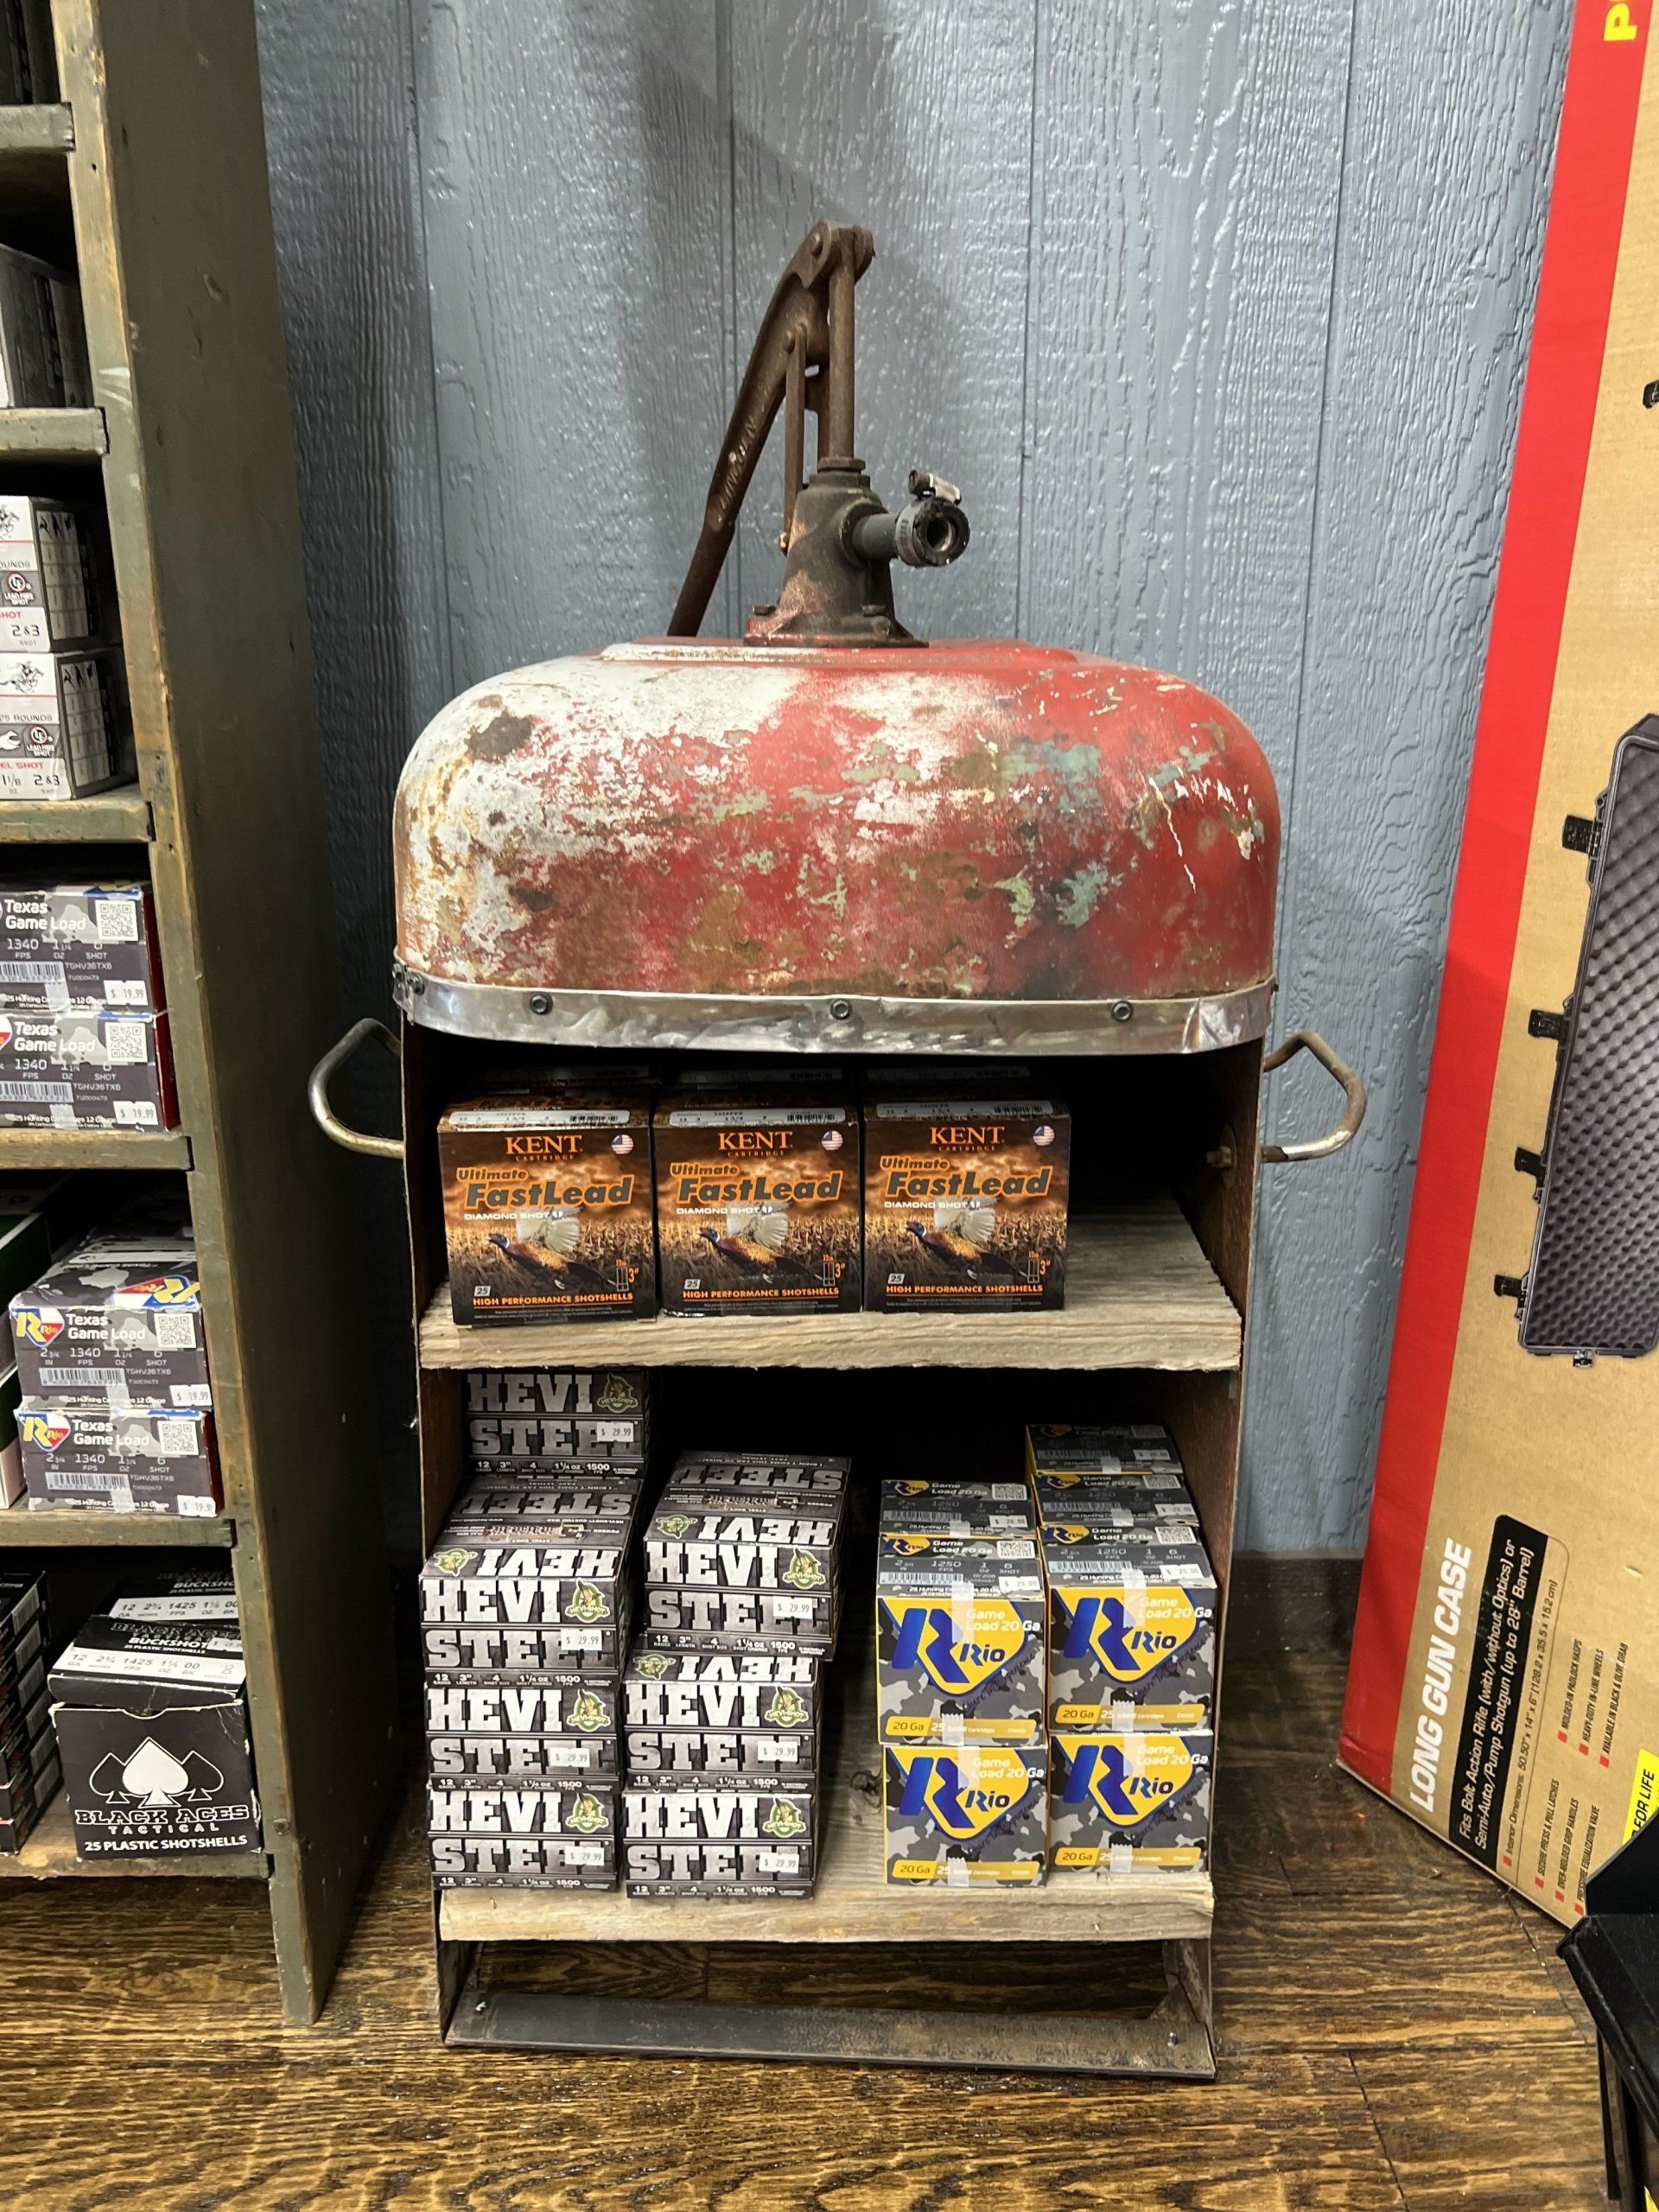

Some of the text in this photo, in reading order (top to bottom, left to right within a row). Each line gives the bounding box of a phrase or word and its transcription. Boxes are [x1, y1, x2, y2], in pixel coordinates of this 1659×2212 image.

[4, 899, 48, 913] Texas
[5, 916, 86, 930] Game Load
[7, 938, 39, 950] 1340
[124, 988, 145, 999] 19.99
[14, 1022, 58, 1036] Texas
[14, 1038, 96, 1052] Game Load
[14, 1058, 48, 1071] 1340
[133, 1109, 154, 1119] 19.99
[717, 1131, 793, 1151] KENT
[930, 1126, 1005, 1145] KENT
[505, 1135, 583, 1154] KENT
[881, 1157, 949, 1169] Ultimate
[457, 1168, 528, 1181] Ultimate
[671, 1164, 740, 1176] Ultimate
[678, 1173, 841, 1202] FastLead
[887, 1168, 1051, 1195] FastLead
[466, 1176, 633, 1208] FastLead
[686, 1280, 699, 1288] 25
[890, 1274, 903, 1283] 25
[476, 1287, 490, 1295] 25
[683, 1287, 839, 1299] HIGH PERFORMANCE SHOTSHELLS
[473, 1293, 633, 1306] HIGH PERFORMANCE SHOTSHELLS
[66, 1313, 109, 1326] Texas
[68, 1327, 146, 1339] Game Load
[69, 1347, 101, 1358] 1340
[188, 1391, 209, 1401] 19.99
[467, 1374, 593, 1413] HEVI
[72, 1419, 113, 1432] Texas
[612, 1427, 631, 1436] 29.99
[73, 1433, 149, 1446] Game Load
[75, 1453, 105, 1464] 1340
[679, 1465, 843, 1491] STEEL
[697, 1516, 833, 1545] HEVI
[476, 1549, 619, 1577] HEVI
[646, 1541, 777, 1587] HEVI
[168, 1601, 197, 1610] 1425
[423, 1580, 561, 1623] HEVI
[790, 1604, 810, 1612] 29.99
[967, 1609, 1005, 1620] Game
[1194, 1607, 1212, 1618] Ga
[965, 1621, 1040, 1631] Load 20 Ga
[129, 1637, 210, 1649] BUCKSHOT
[578, 1636, 599, 1645] 29.99
[771, 1641, 795, 1650] 1500
[1131, 1631, 1177, 1653] Rio
[959, 1643, 1005, 1666] Rio
[123, 1657, 154, 1666] 1425
[677, 1656, 812, 1681] HEVI
[1409, 1537, 1471, 1812] LONG GUN CASE
[1614, 1662, 1625, 1682] OLIVE
[1459, 1539, 1516, 1840] Fits Bolt Action Rifle (with/without Optics) or
[1582, 1700, 1597, 1743] HEAVY-DUTY
[1593, 1648, 1605, 1678] WHEELS
[1475, 1546, 1535, 1850] Semi-Auto/Pump Shotgun (up to 28" Barrel)
[1611, 1686, 1621, 1712] BLACK
[428, 1688, 562, 1732] HEVI
[626, 1684, 760, 1726] HEVI
[1063, 1709, 1077, 1718] 20
[909, 1722, 925, 1731] Ga
[1602, 1717, 1614, 1755] AVAILABLE
[568, 1753, 588, 1762] 29.99
[973, 1758, 1010, 1768] Game
[1191, 1754, 1209, 1764] Ga
[1027, 1768, 1045, 1778] Ga
[1128, 1777, 1173, 1798] Rio
[1639, 1768, 1655, 1801] LIFE
[965, 1790, 1010, 1811] Rio
[75, 1805, 250, 1825] BLACK ACES
[430, 1791, 562, 1832] HEVI
[625, 1796, 759, 1838] HEVI
[1590, 1803, 1600, 1827] VALVE
[1634, 1802, 1649, 1831] FOR
[109, 1822, 219, 1834] TACTICAL
[85, 1835, 248, 1851] 25 PLASTIC SHOTSHELLS
[582, 1853, 601, 1861] 29.99
[1062, 1852, 1077, 1860] 20
[916, 1866, 931, 1874] Ga
